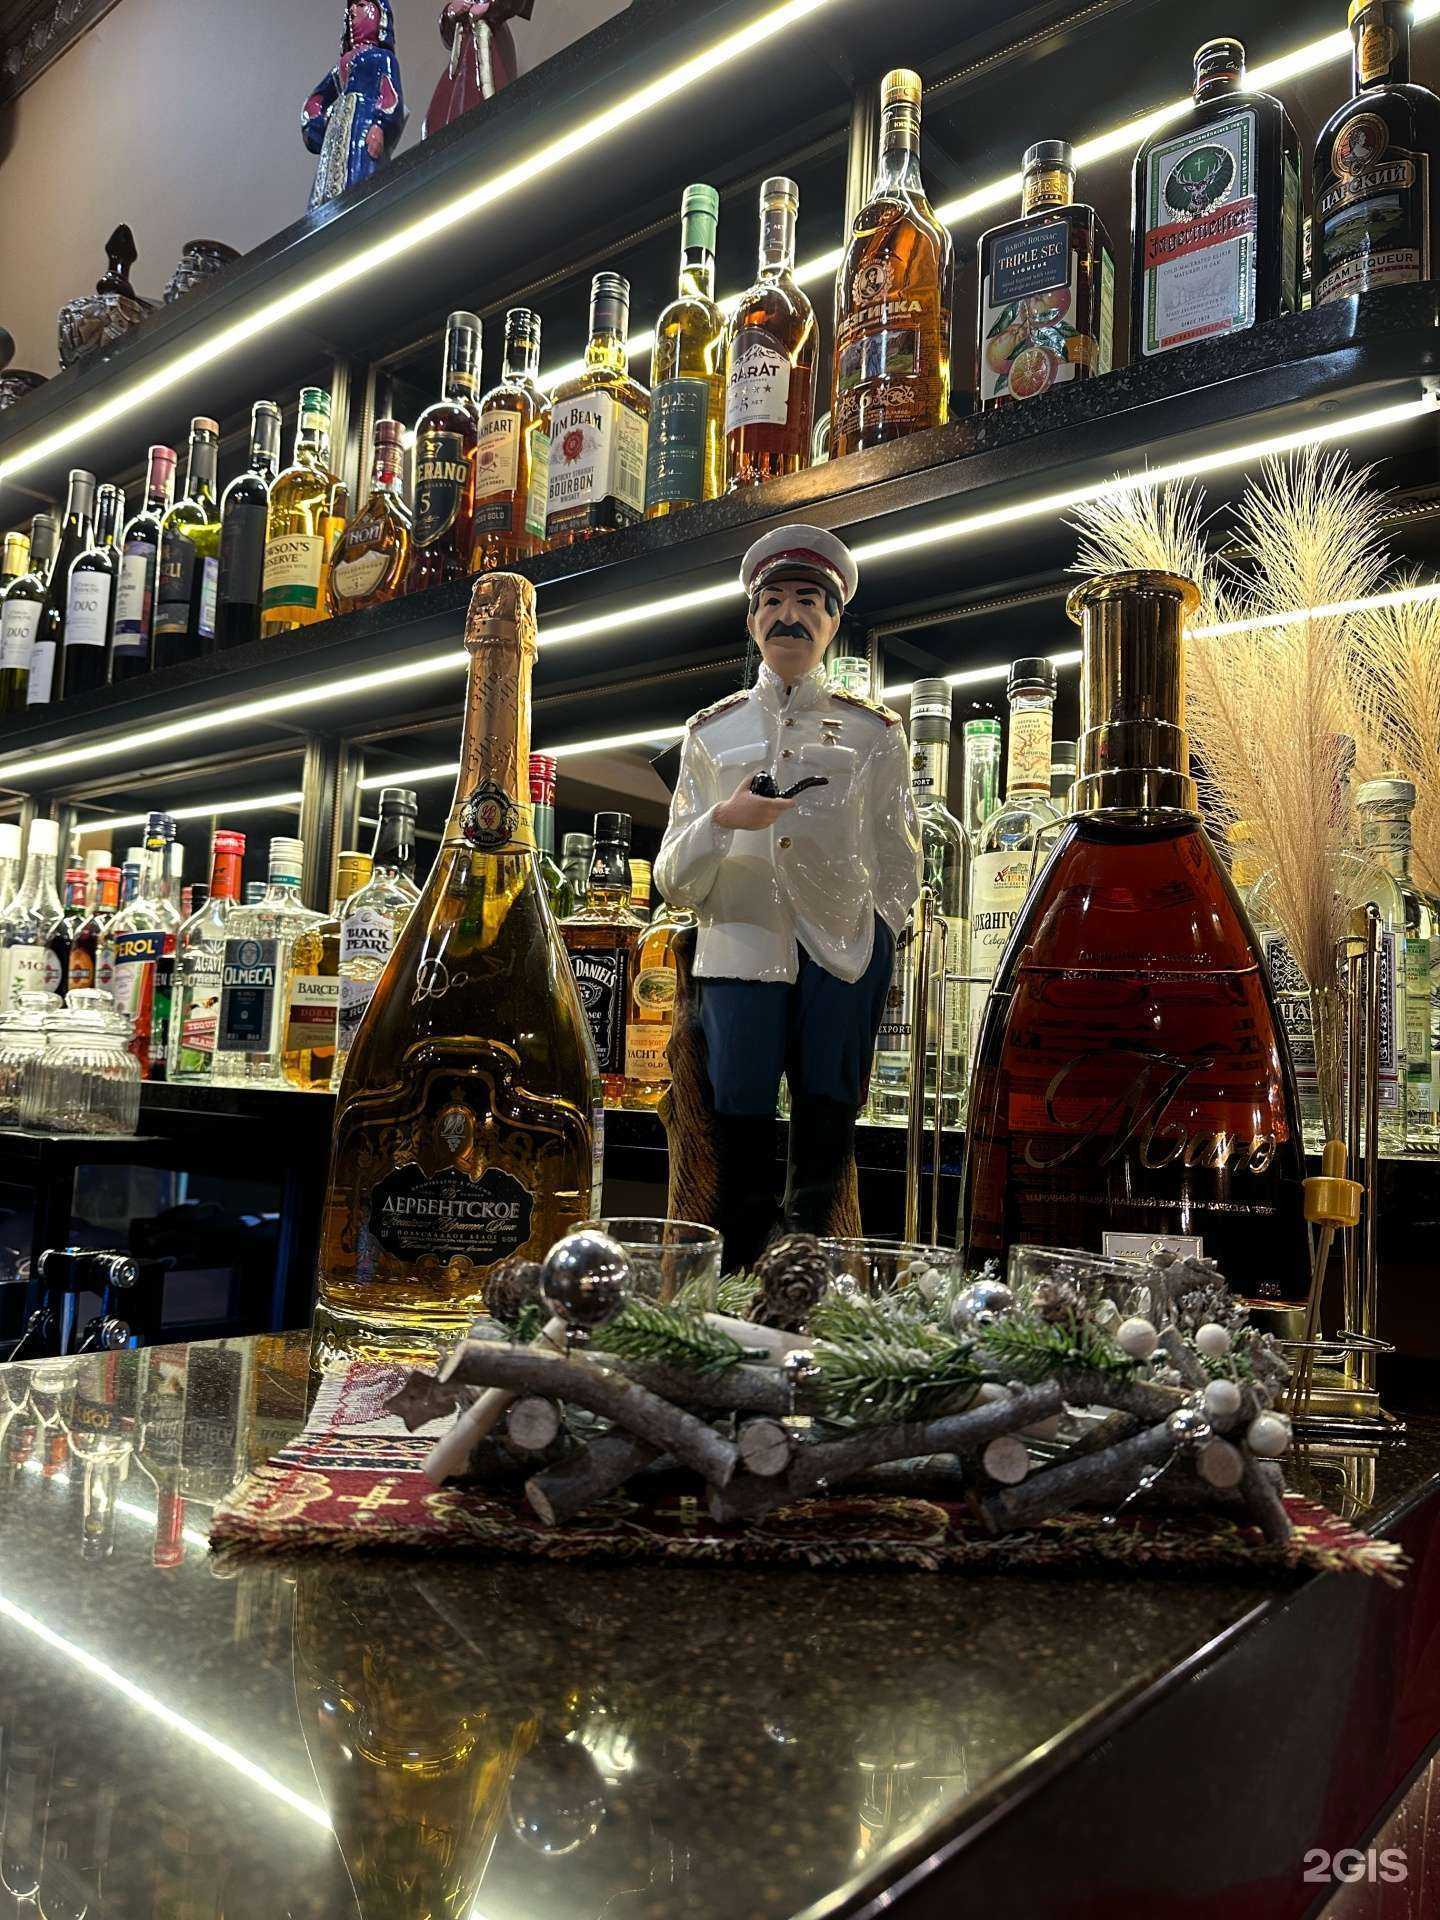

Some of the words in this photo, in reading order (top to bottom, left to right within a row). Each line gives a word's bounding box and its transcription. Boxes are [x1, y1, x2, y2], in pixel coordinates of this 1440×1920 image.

[1322, 165, 1407, 213] ЦАРСКИЙ
[998, 248, 1038, 271] TRIPLE
[1041, 242, 1063, 259] SEC
[1317, 267, 1350, 296] CREAM
[1355, 253, 1415, 272] LIQUEUR
[730, 362, 780, 384] RARAT
[551, 416, 568, 445] JIM
[570, 408, 602, 431] BEAM
[418, 461, 467, 483] ERANO
[549, 474, 593, 499] BOURBON
[73, 601, 98, 611] DUO
[7, 627, 30, 638] DUO
[346, 928, 391, 941] BLACK
[115, 939, 155, 957] EROL
[345, 939, 393, 953] PEARL
[223, 966, 274, 985] OLMECA
[576, 959, 618, 987] DANIEL'S
[382, 1195, 520, 1219] ДЕРБЕНТСКОЕ
